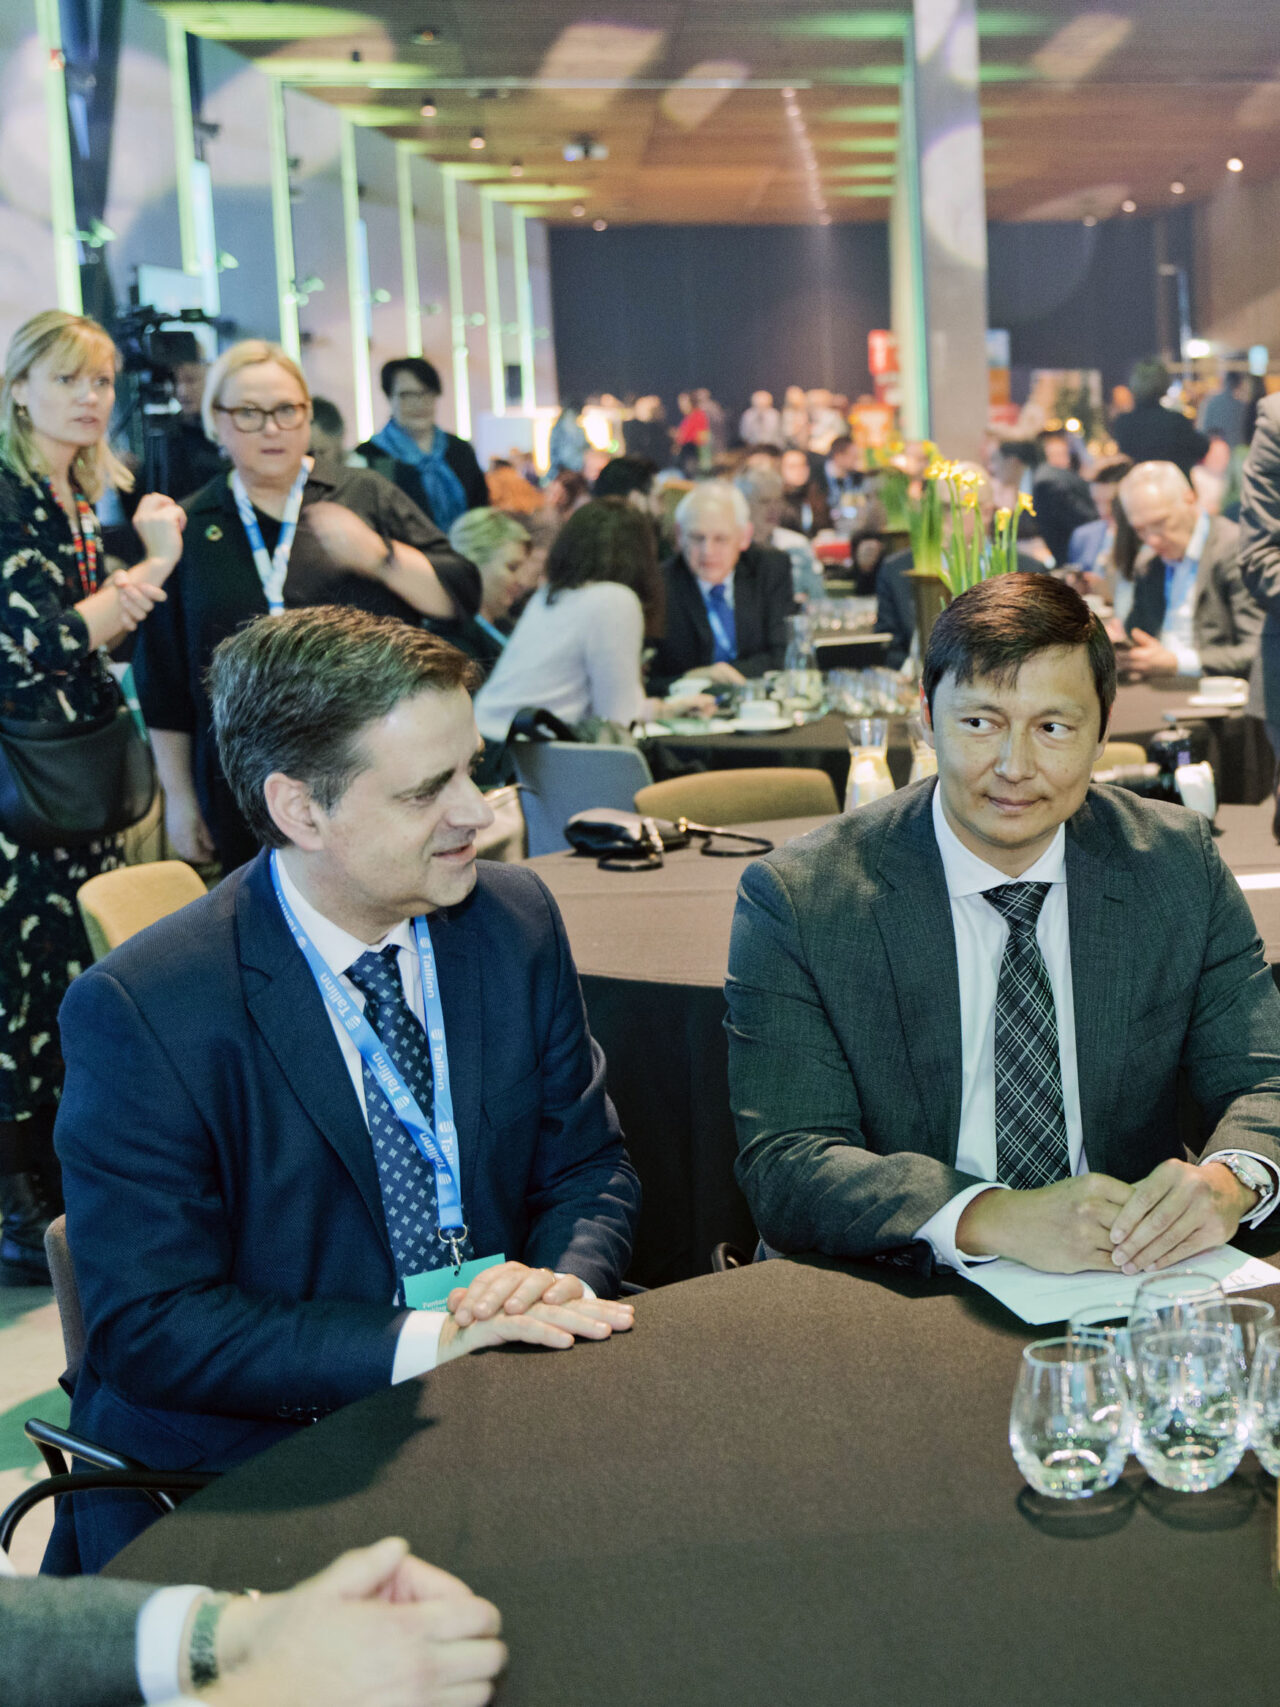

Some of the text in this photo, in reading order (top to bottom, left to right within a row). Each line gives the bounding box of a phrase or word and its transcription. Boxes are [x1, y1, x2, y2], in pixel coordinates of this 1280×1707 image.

[319, 972, 351, 1017] Tallinn
[423, 954, 435, 999] Tallinn
[371, 1052, 401, 1096] Tallinn
[433, 1044, 445, 1091] Tallinn
[419, 1132, 447, 1170] Tallinn
[441, 1136, 454, 1165] Tall
